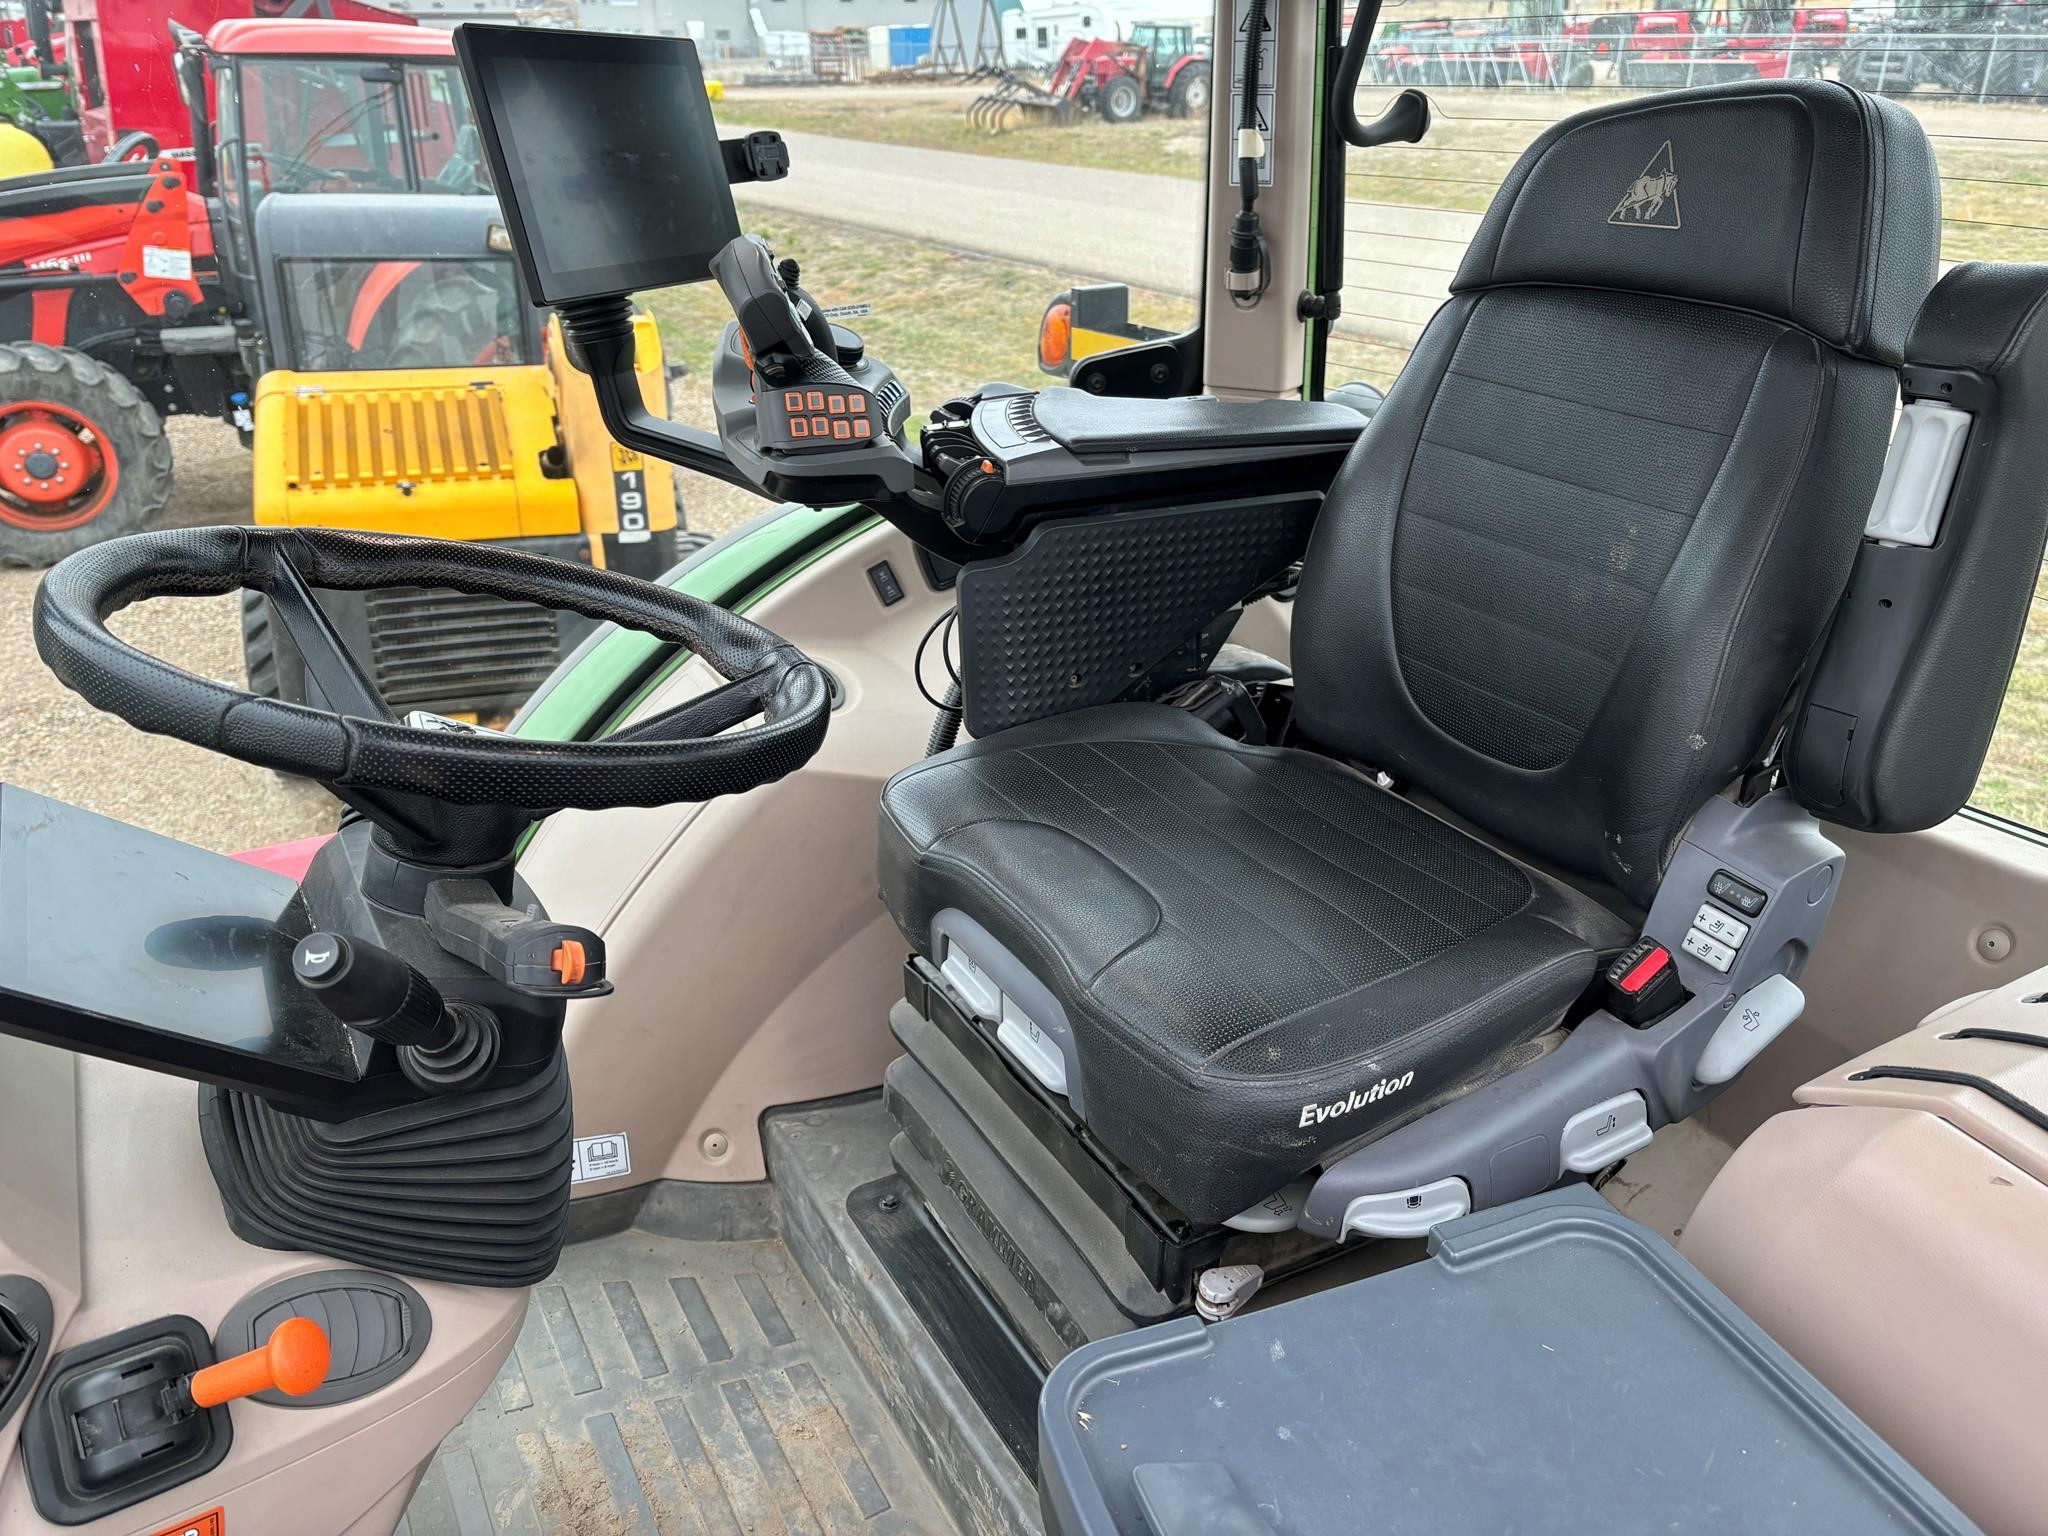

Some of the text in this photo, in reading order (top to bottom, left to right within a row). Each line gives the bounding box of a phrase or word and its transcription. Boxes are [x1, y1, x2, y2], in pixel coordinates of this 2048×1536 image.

[620, 471, 645, 530] 190
[1298, 1070, 1415, 1128] Evolution
[958, 1179, 1036, 1298] GRAMMER
